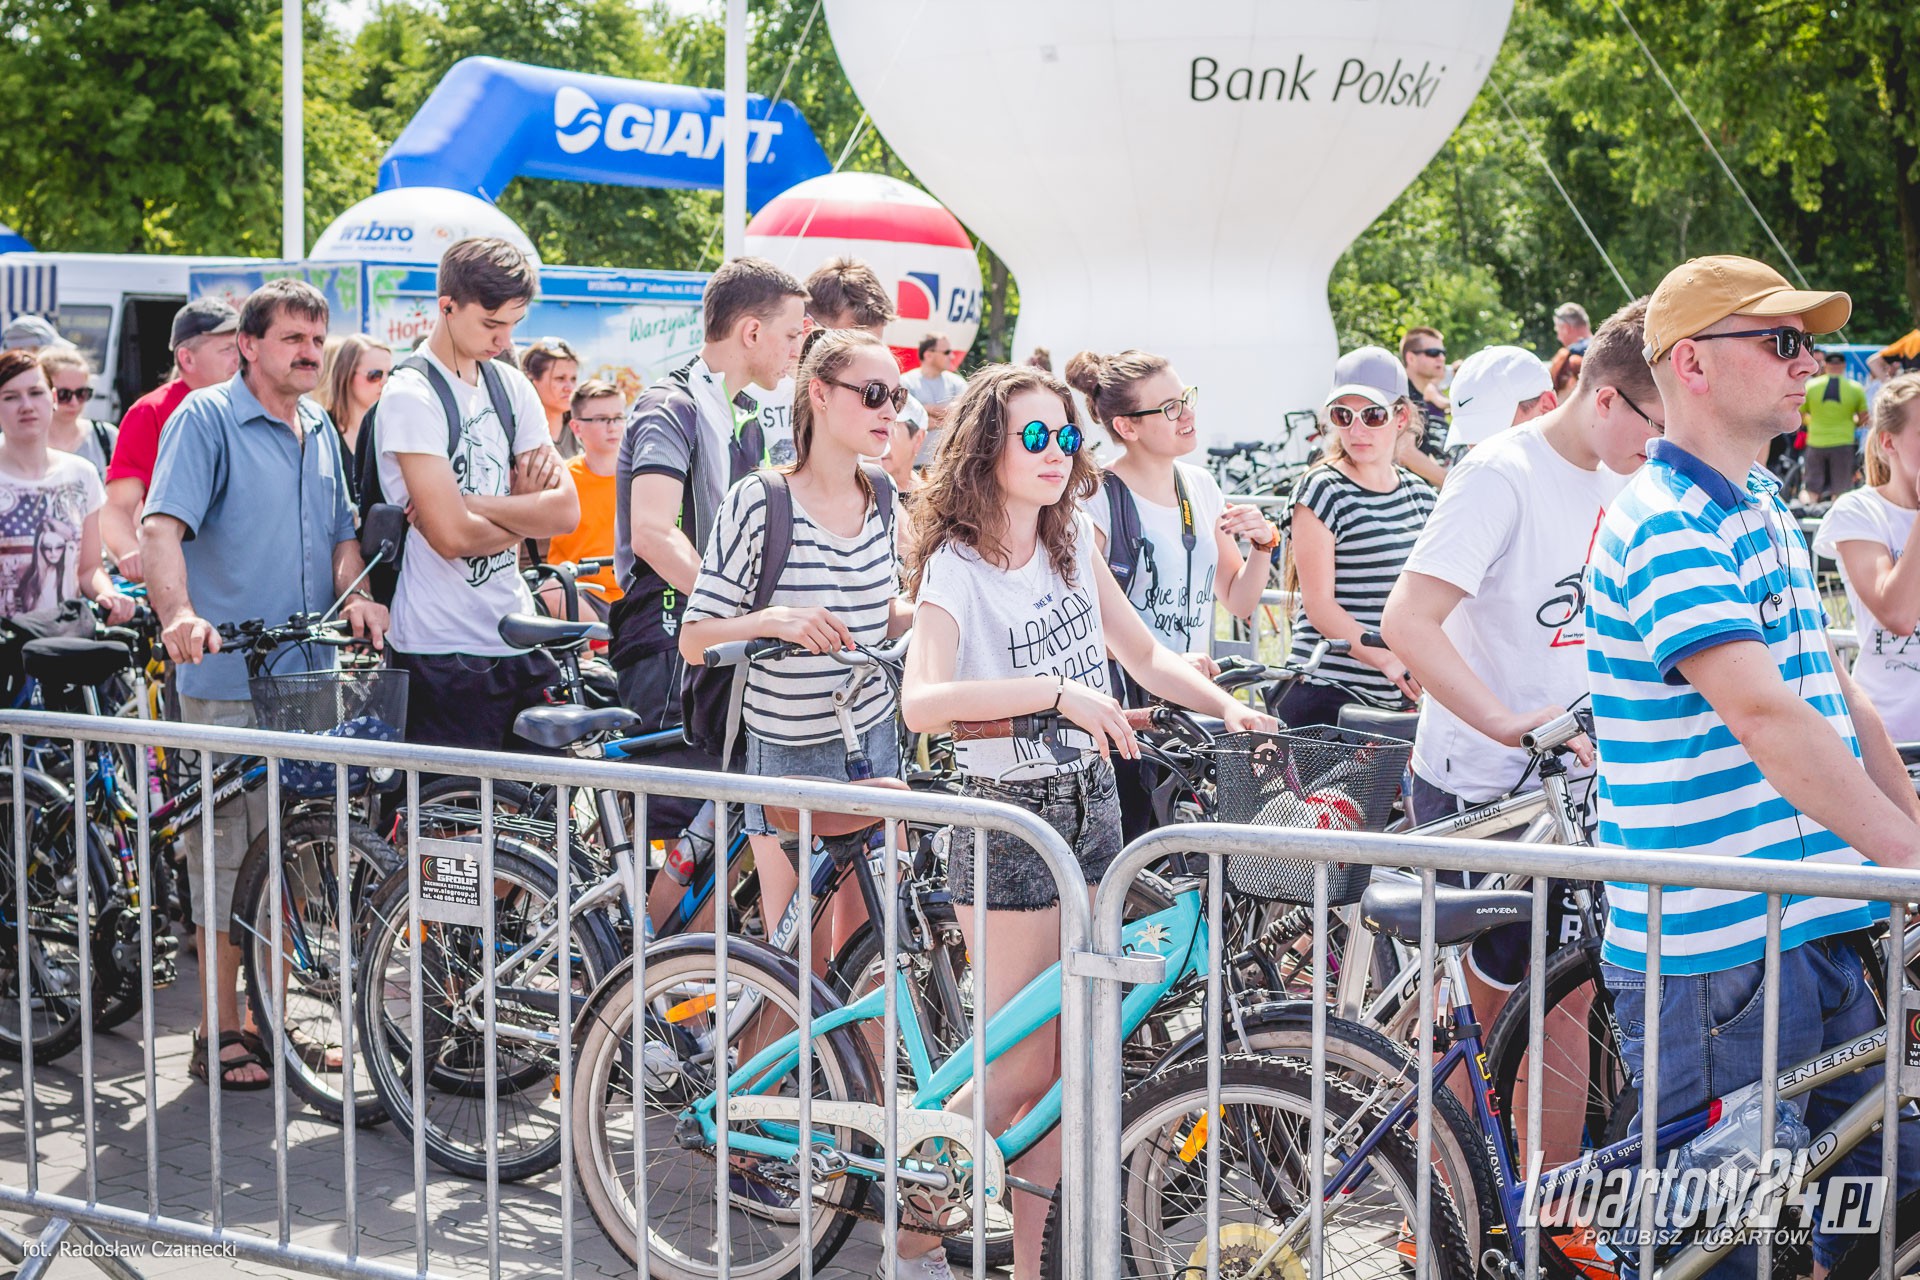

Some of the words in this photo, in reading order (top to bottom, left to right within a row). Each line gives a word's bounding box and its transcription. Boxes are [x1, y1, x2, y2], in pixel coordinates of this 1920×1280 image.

[1190, 53, 1318, 102] Bank
[1332, 57, 1447, 108] Polski
[604, 102, 783, 164] GIANT
[662, 612, 678, 637] 4F
[1008, 587, 1097, 668] LONDON
[1453, 805, 1501, 829] MOTION
[437, 874, 478, 886] GROUP
[1776, 1029, 1888, 1092] ENERGY
[1601, 1150, 1616, 1165] 21
[1617, 1140, 1644, 1161] spee
